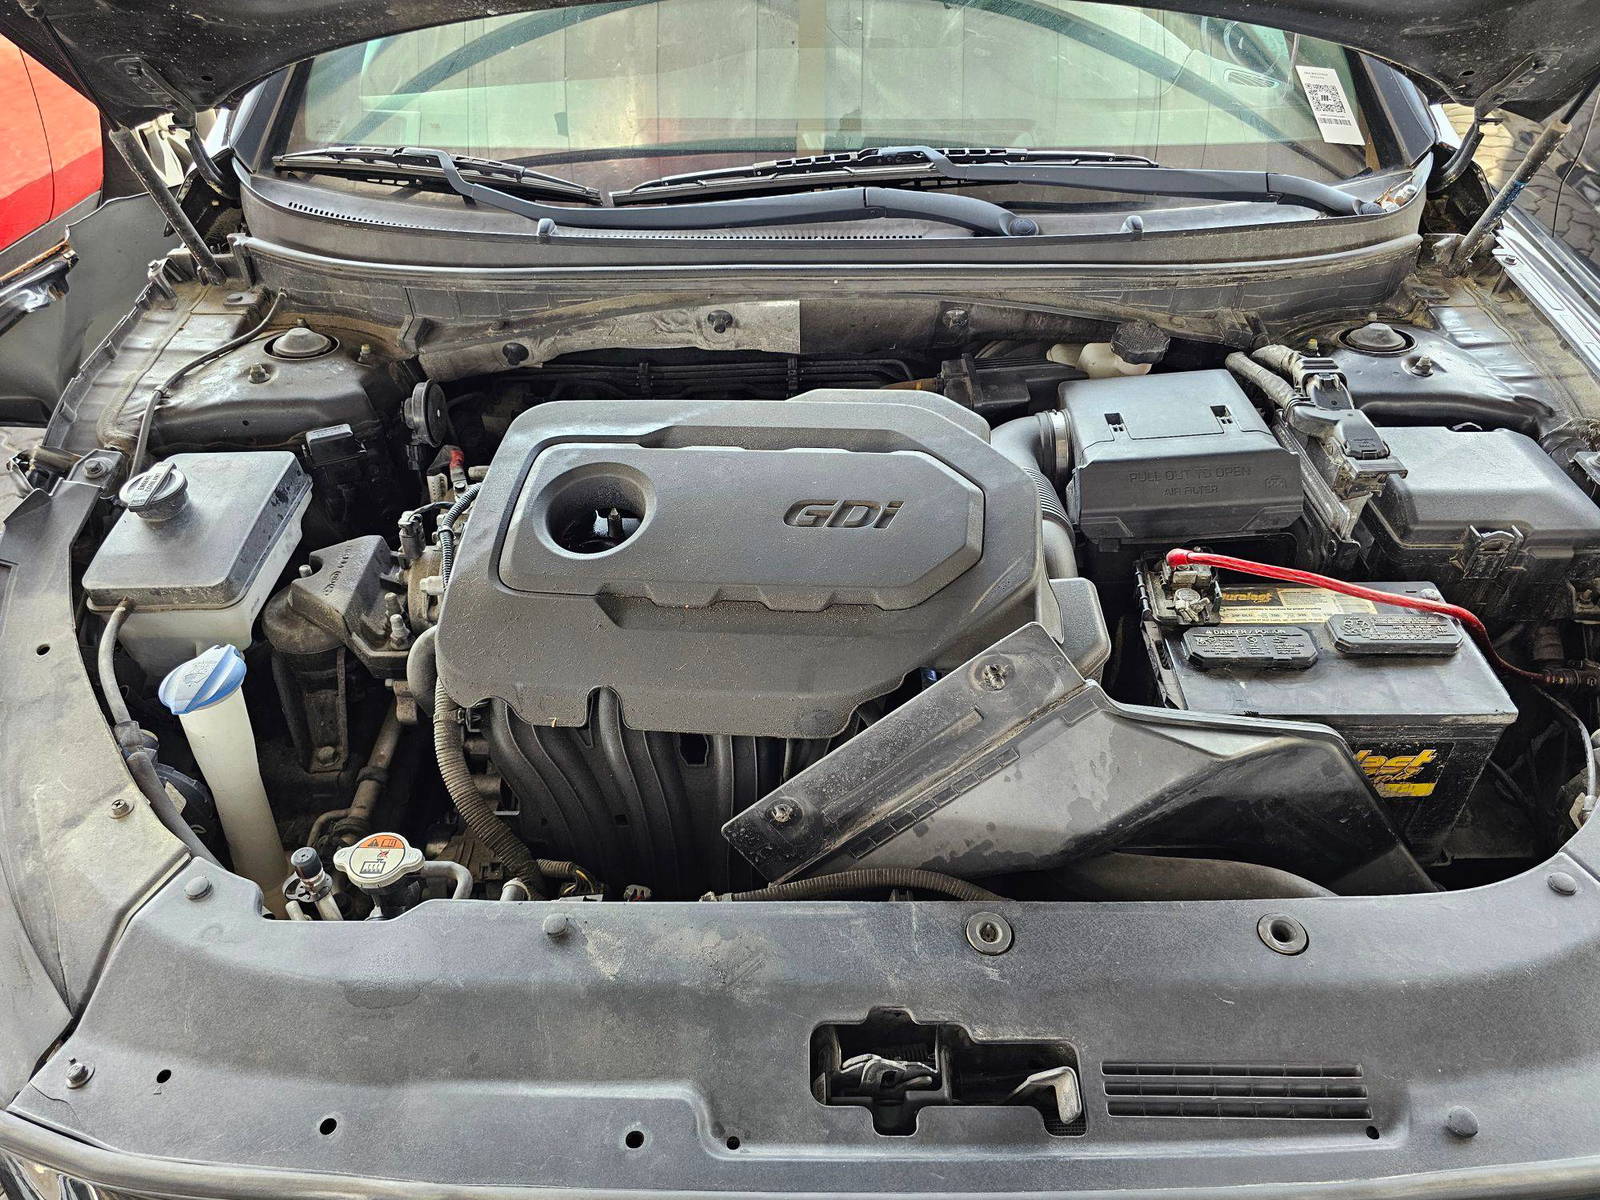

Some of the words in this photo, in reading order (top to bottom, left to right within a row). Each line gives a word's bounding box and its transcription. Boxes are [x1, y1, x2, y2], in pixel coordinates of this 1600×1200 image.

[1129, 472, 1162, 483] PULL
[1165, 470, 1192, 481] OUT
[1197, 468, 1213, 479] TO
[1216, 466, 1251, 478] OPEN
[1164, 486, 1181, 496] AIR
[1184, 484, 1218, 496] FILTER
